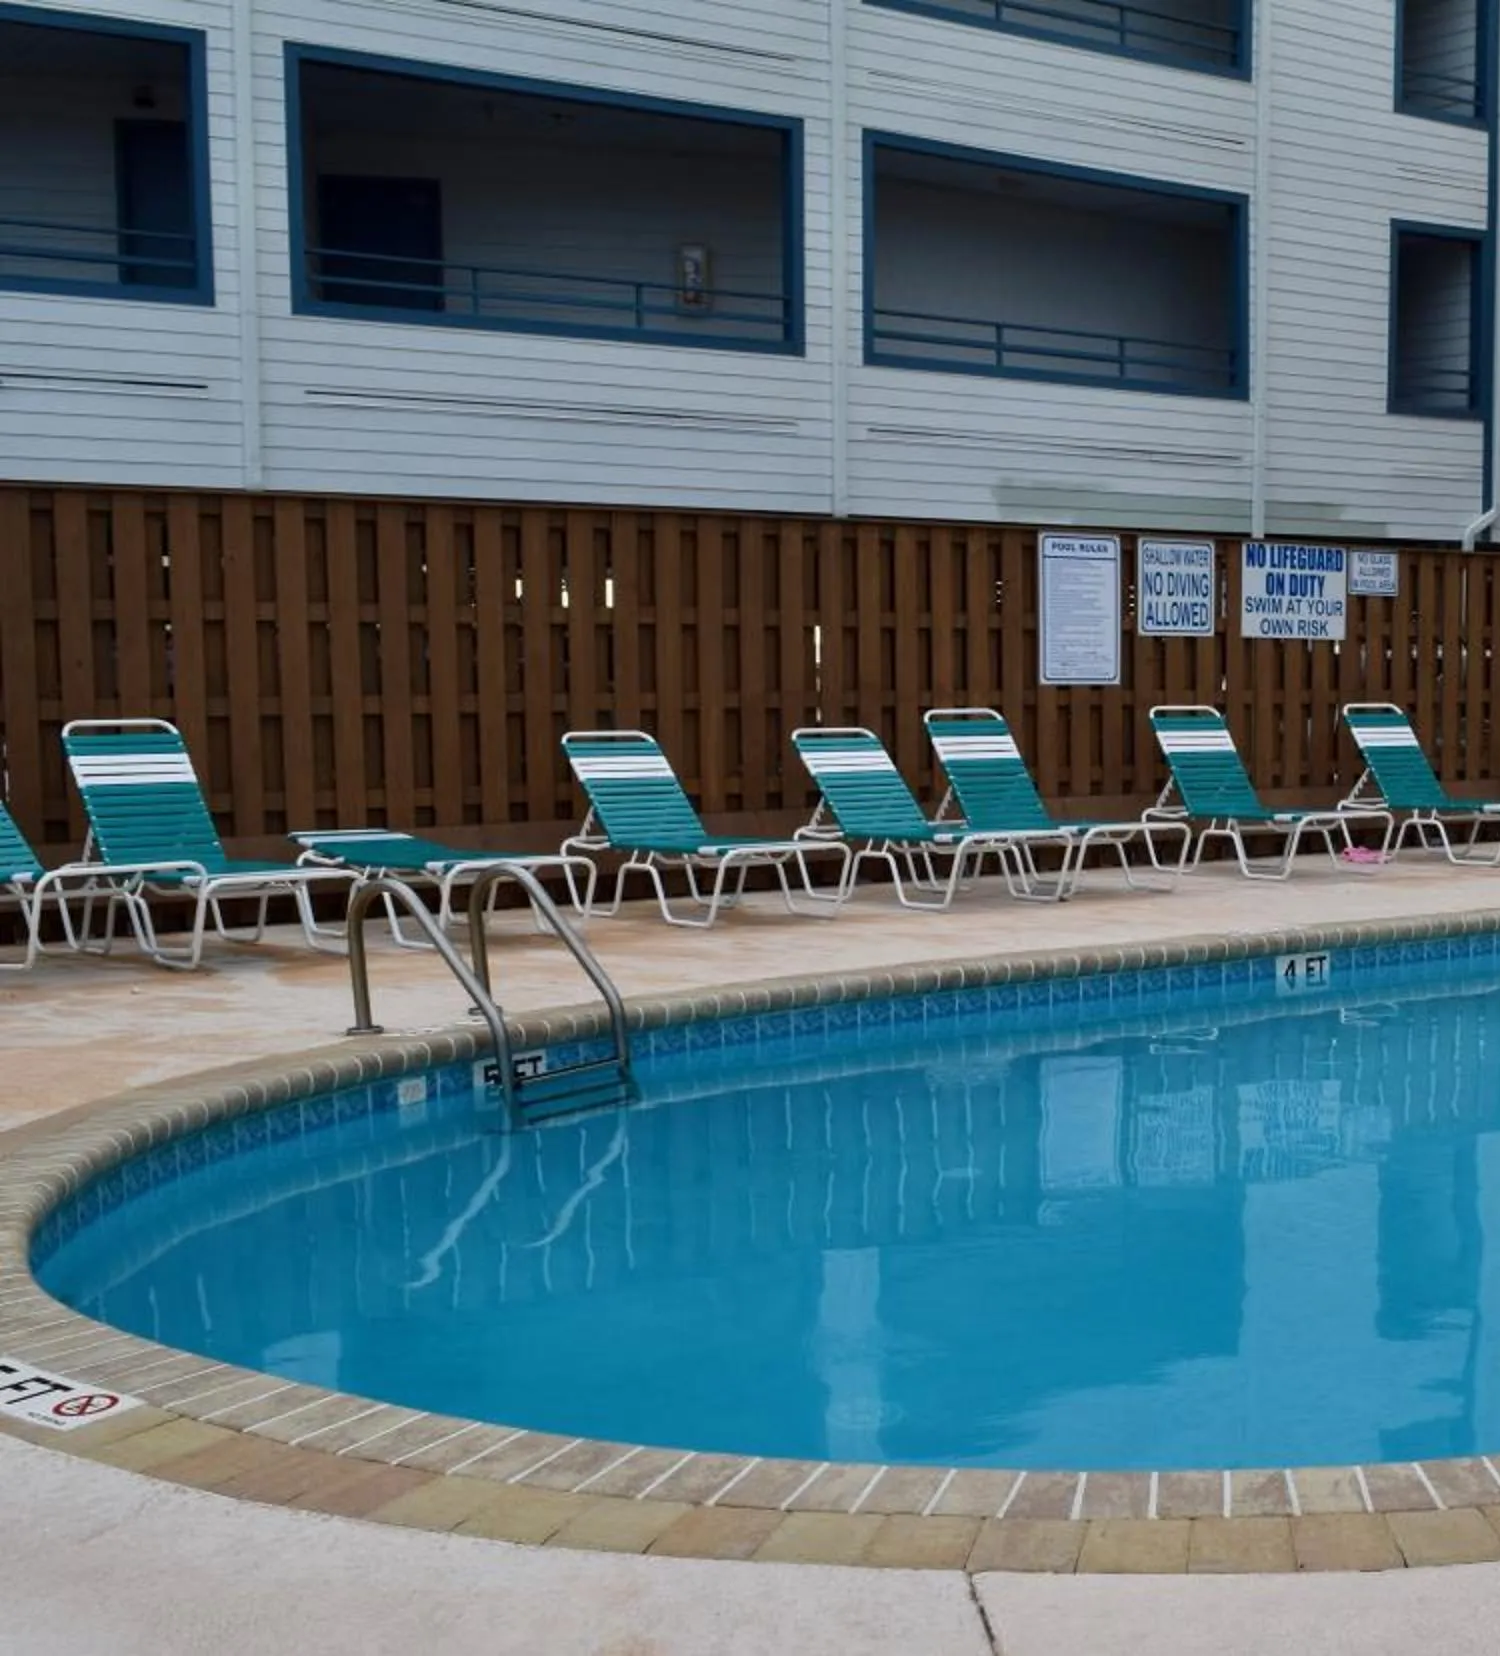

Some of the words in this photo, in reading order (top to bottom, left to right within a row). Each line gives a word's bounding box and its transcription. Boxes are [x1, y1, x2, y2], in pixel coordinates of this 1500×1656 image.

[1051, 542, 1076, 552] POOL
[1080, 543, 1109, 553] RULES
[1144, 546, 1182, 566] SHALLOW
[1183, 549, 1209, 567] WATER
[1245, 544, 1266, 568] NO
[1270, 545, 1344, 572] LIFEGUARD
[1144, 571, 1163, 597] NO
[1167, 571, 1209, 598] DIVING
[1266, 572, 1284, 597] ON
[1289, 573, 1325, 598] DUTY
[1145, 602, 1209, 627] ALLOWED
[1245, 596, 1282, 615] SWIM
[1286, 598, 1302, 615] AT
[1307, 599, 1343, 617] YOUR
[1260, 618, 1293, 635] OWN
[1298, 619, 1328, 637] RISK
